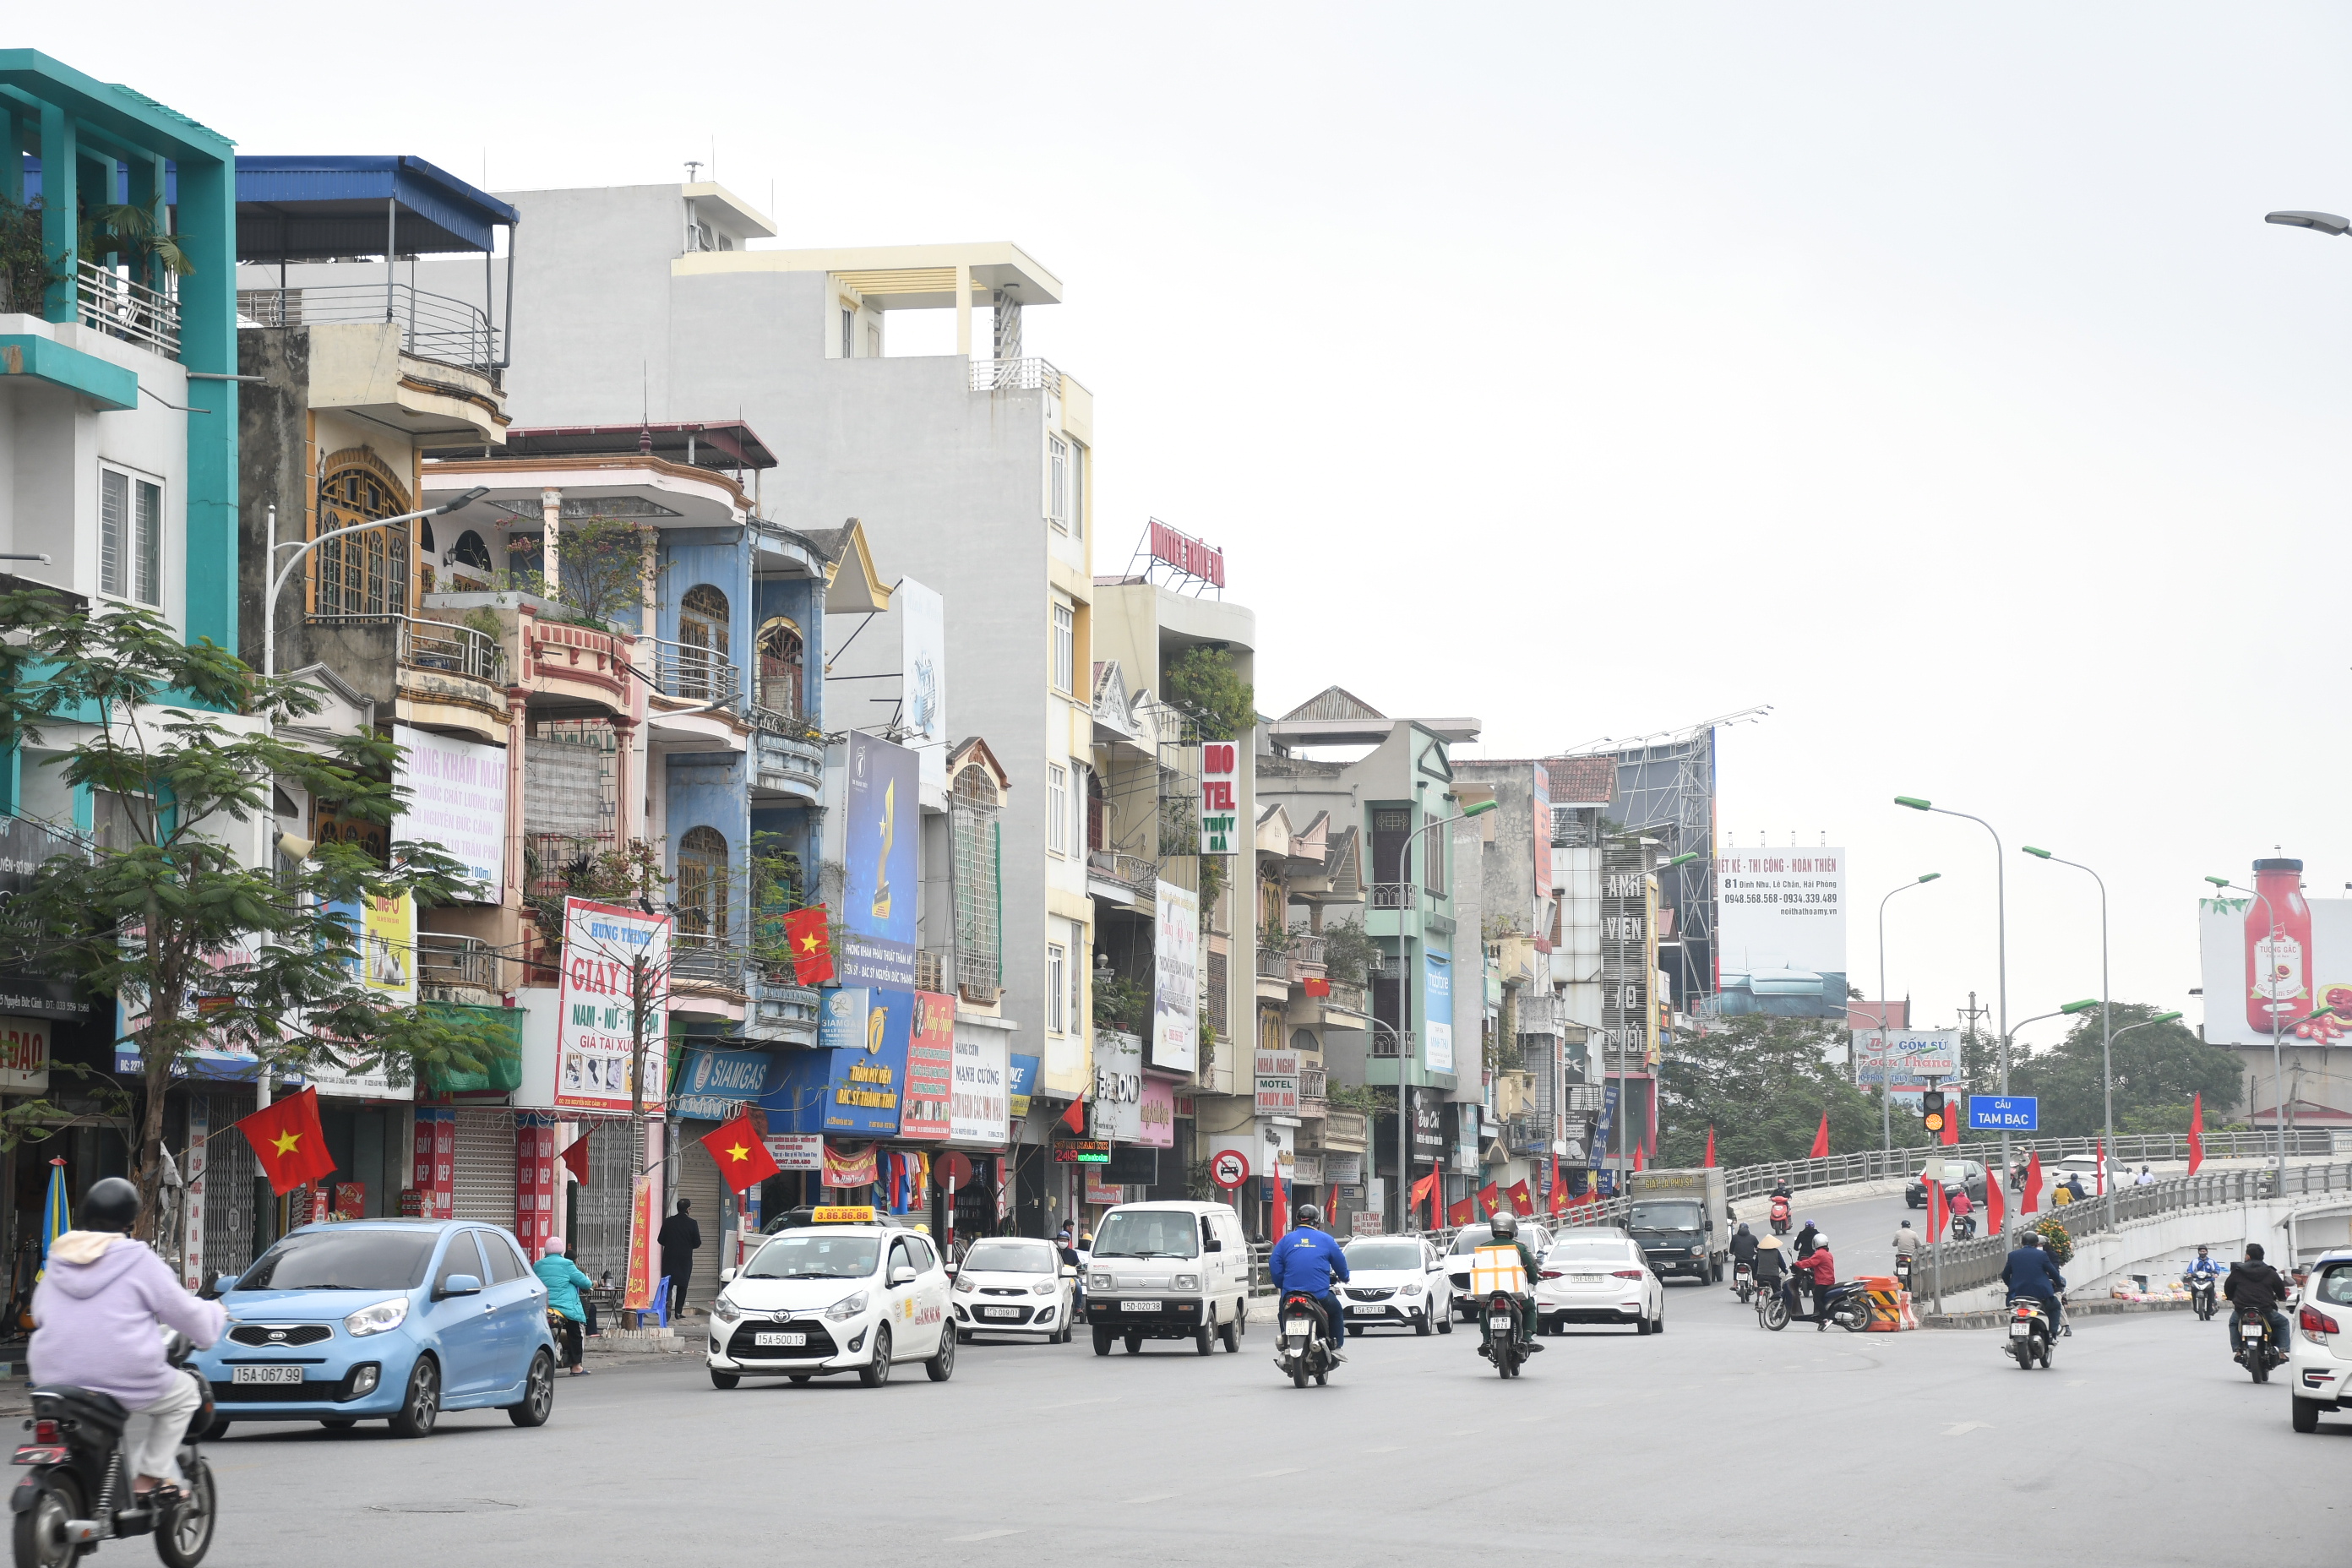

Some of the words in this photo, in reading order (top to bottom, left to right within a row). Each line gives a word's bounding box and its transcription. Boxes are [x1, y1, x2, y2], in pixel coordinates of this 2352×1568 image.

[1205, 744, 1234, 773] MO
[480, 752, 505, 790] MẮT
[1203, 781, 1235, 809] TEL
[490, 798, 503, 813] CAO
[1203, 814, 1235, 832] THÚY
[1210, 831, 1228, 851] HÀ
[1732, 854, 1741, 874] KẾ
[1749, 858, 1761, 874] THI
[1763, 856, 1784, 873] CÔNG
[1792, 856, 1812, 873] HOÀN
[1815, 855, 1837, 875] THIỆN
[1608, 866, 1641, 897] ẢNH
[1724, 879, 1738, 889] 81
[1772, 880, 1781, 889] Lê
[1783, 880, 1801, 890] Chân,
[1803, 879, 1815, 889] Hải
[1816, 879, 1837, 890] Phòng
[1780, 907, 1838, 916] noithathoamy.vn
[1607, 912, 1641, 945] VIỆN
[846, 942, 860, 957] PHÒNG
[875, 966, 890, 983] NGUYỄN
[4, 994, 20, 1010] Nguyễn
[31, 997, 42, 1009] Cảnh
[573, 1004, 596, 1028] NAM
[604, 1003, 619, 1030] NỮ
[580, 1033, 596, 1049] GIÁ
[600, 1037, 614, 1054] TẠI
[969, 1043, 979, 1057] CƠM
[1899, 1037, 1927, 1051] GỐM
[1257, 1054, 1274, 1073] NHÀ
[1276, 1053, 1296, 1074] NGHỈ
[711, 1059, 766, 1090] SIAMGAS
[956, 1064, 975, 1086] MẠNH
[977, 1063, 999, 1086] CƯỜNG
[1260, 1080, 1293, 1089] MOTEL
[1257, 1091, 1280, 1106] THÚY
[1282, 1091, 1294, 1106] HÀ
[1995, 1098, 2012, 1109] CẦU
[1978, 1113, 2001, 1124] TAM
[2005, 1113, 2029, 1127] BẠC
[1054, 1150, 1078, 1162] 249
[436, 1192, 451, 1209] NAM
[520, 1195, 534, 1211] NAM
[538, 1195, 551, 1211] NAM
[1362, 1213, 1369, 1222] XE
[759, 1335, 804, 1344] 15A-500.13
[237, 1369, 300, 1382] 15A-067.99
